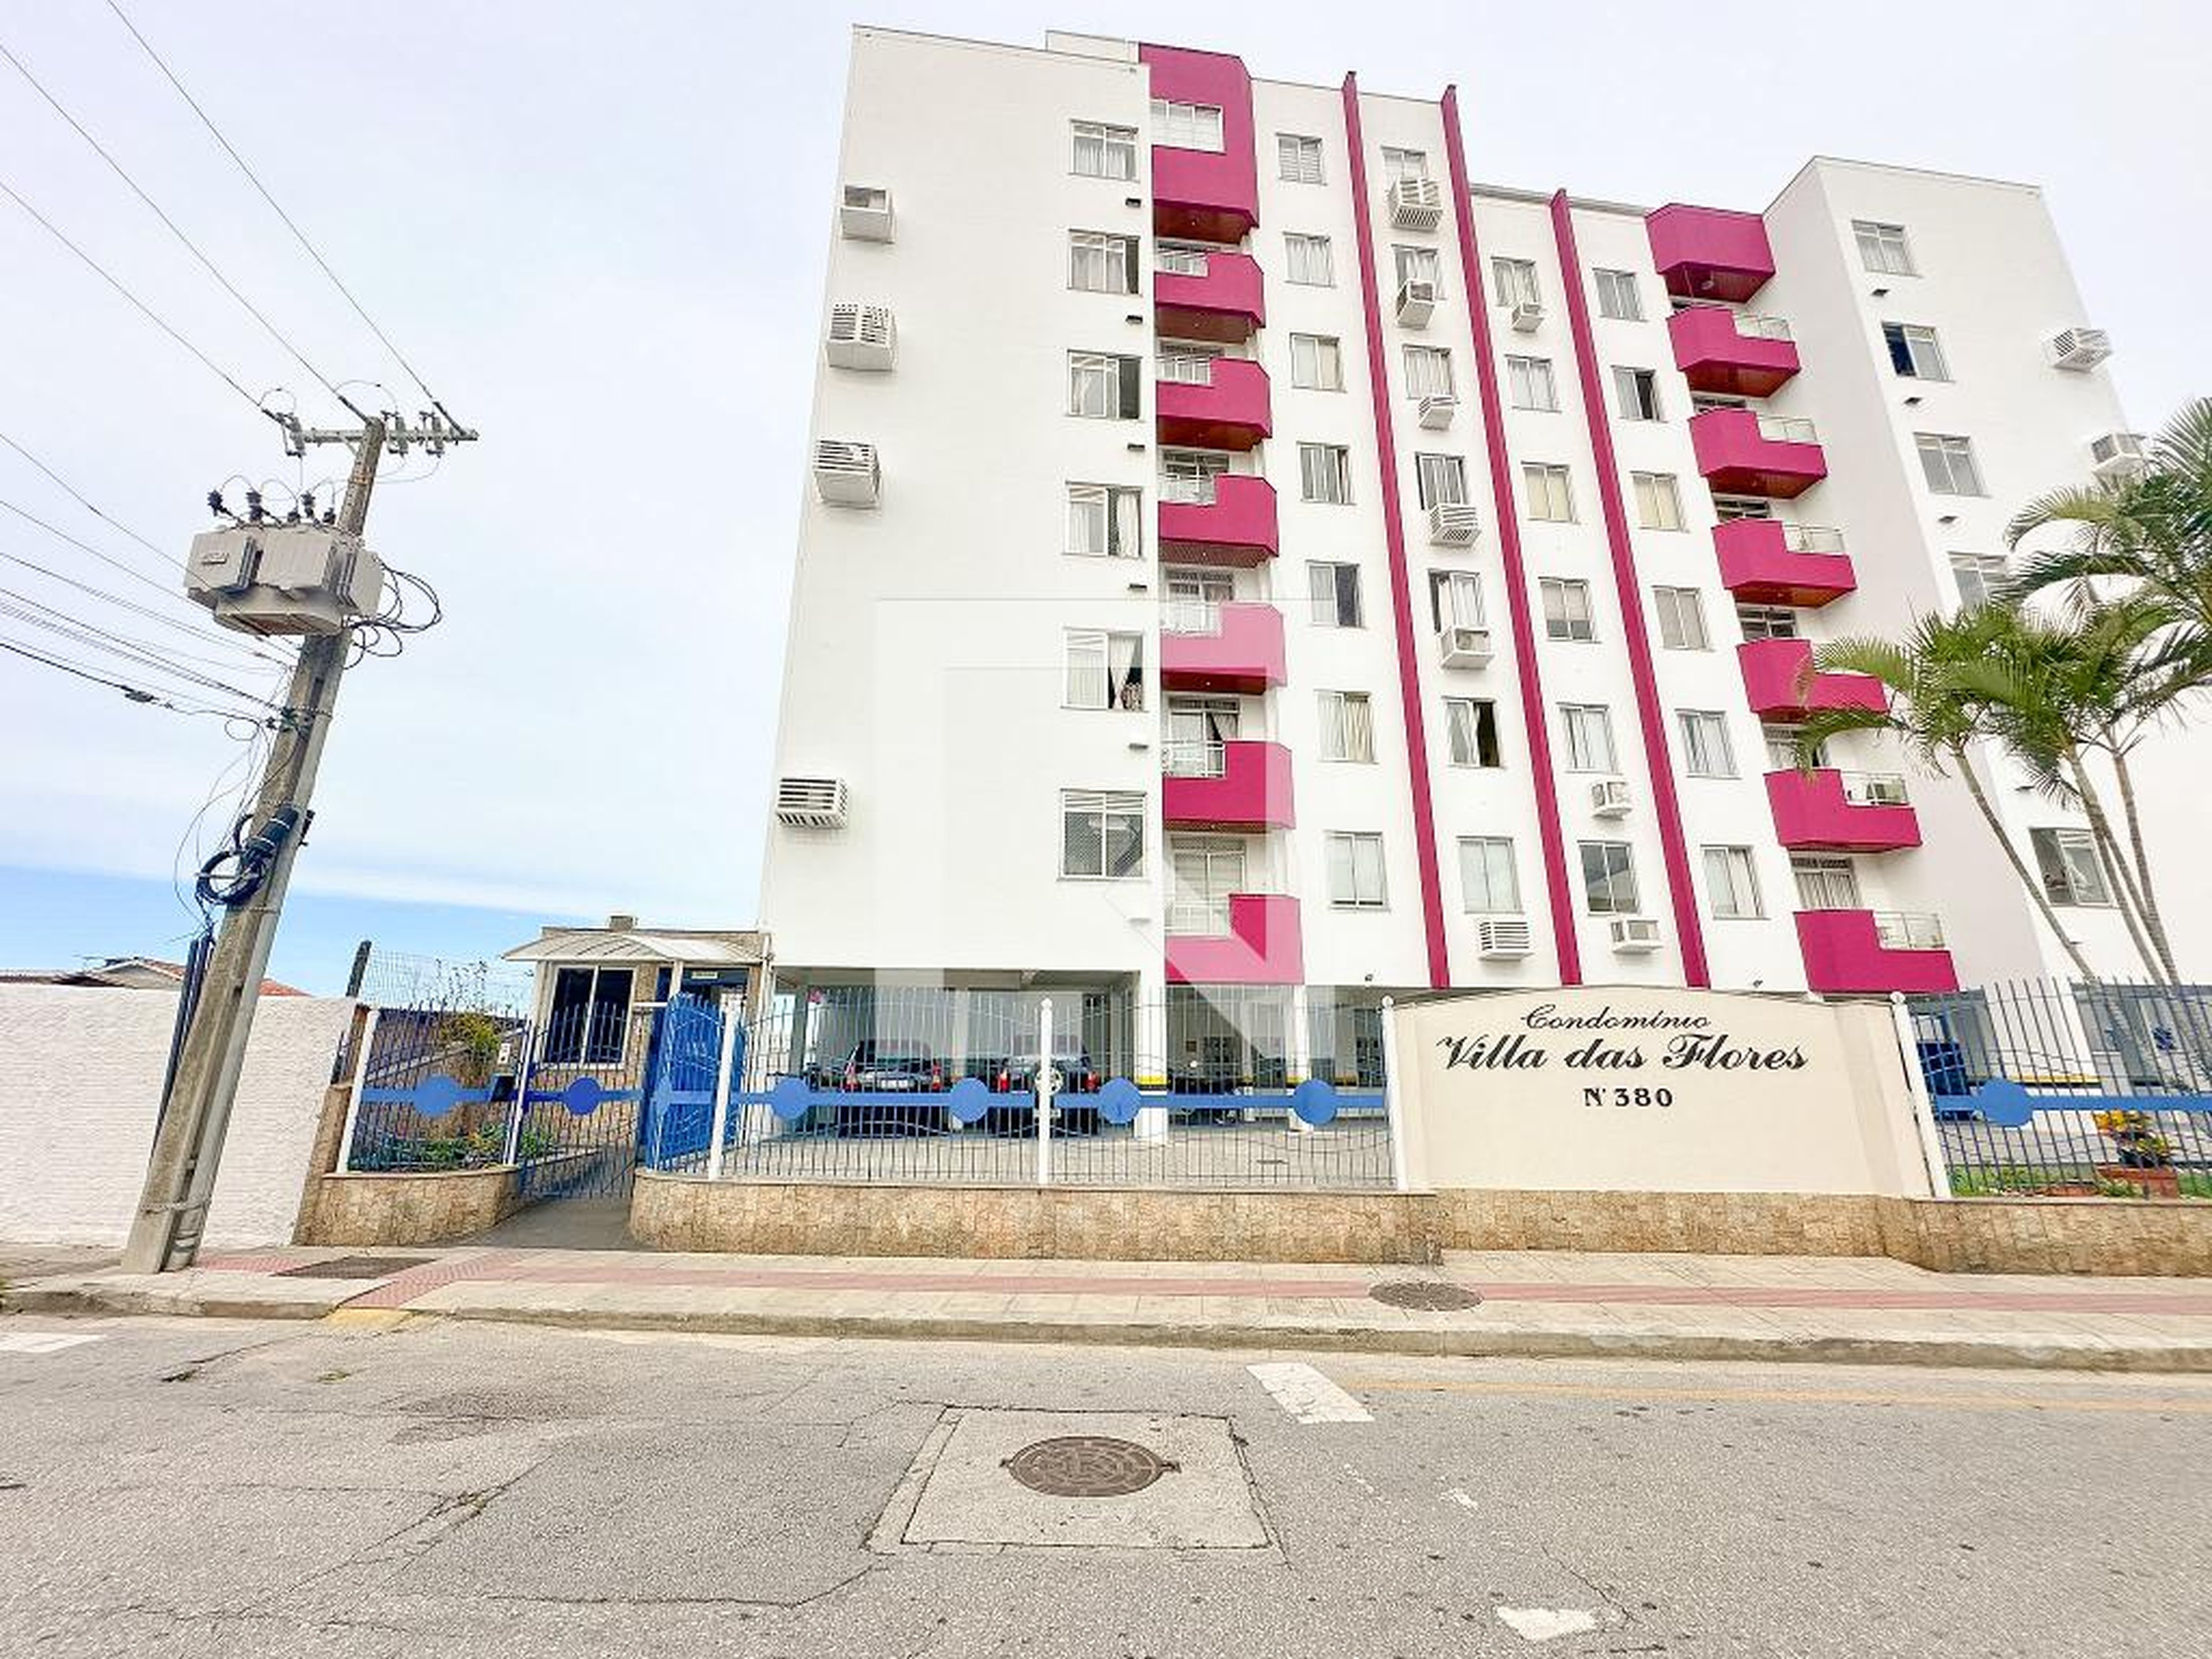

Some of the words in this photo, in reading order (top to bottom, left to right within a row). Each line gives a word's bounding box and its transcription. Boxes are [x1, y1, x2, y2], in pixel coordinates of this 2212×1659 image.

[1436, 1033, 1549, 1070] Villa
[1563, 1038, 1649, 1070] das
[1662, 1033, 1809, 1070] Flores
[1614, 1088, 1673, 1108] 380
